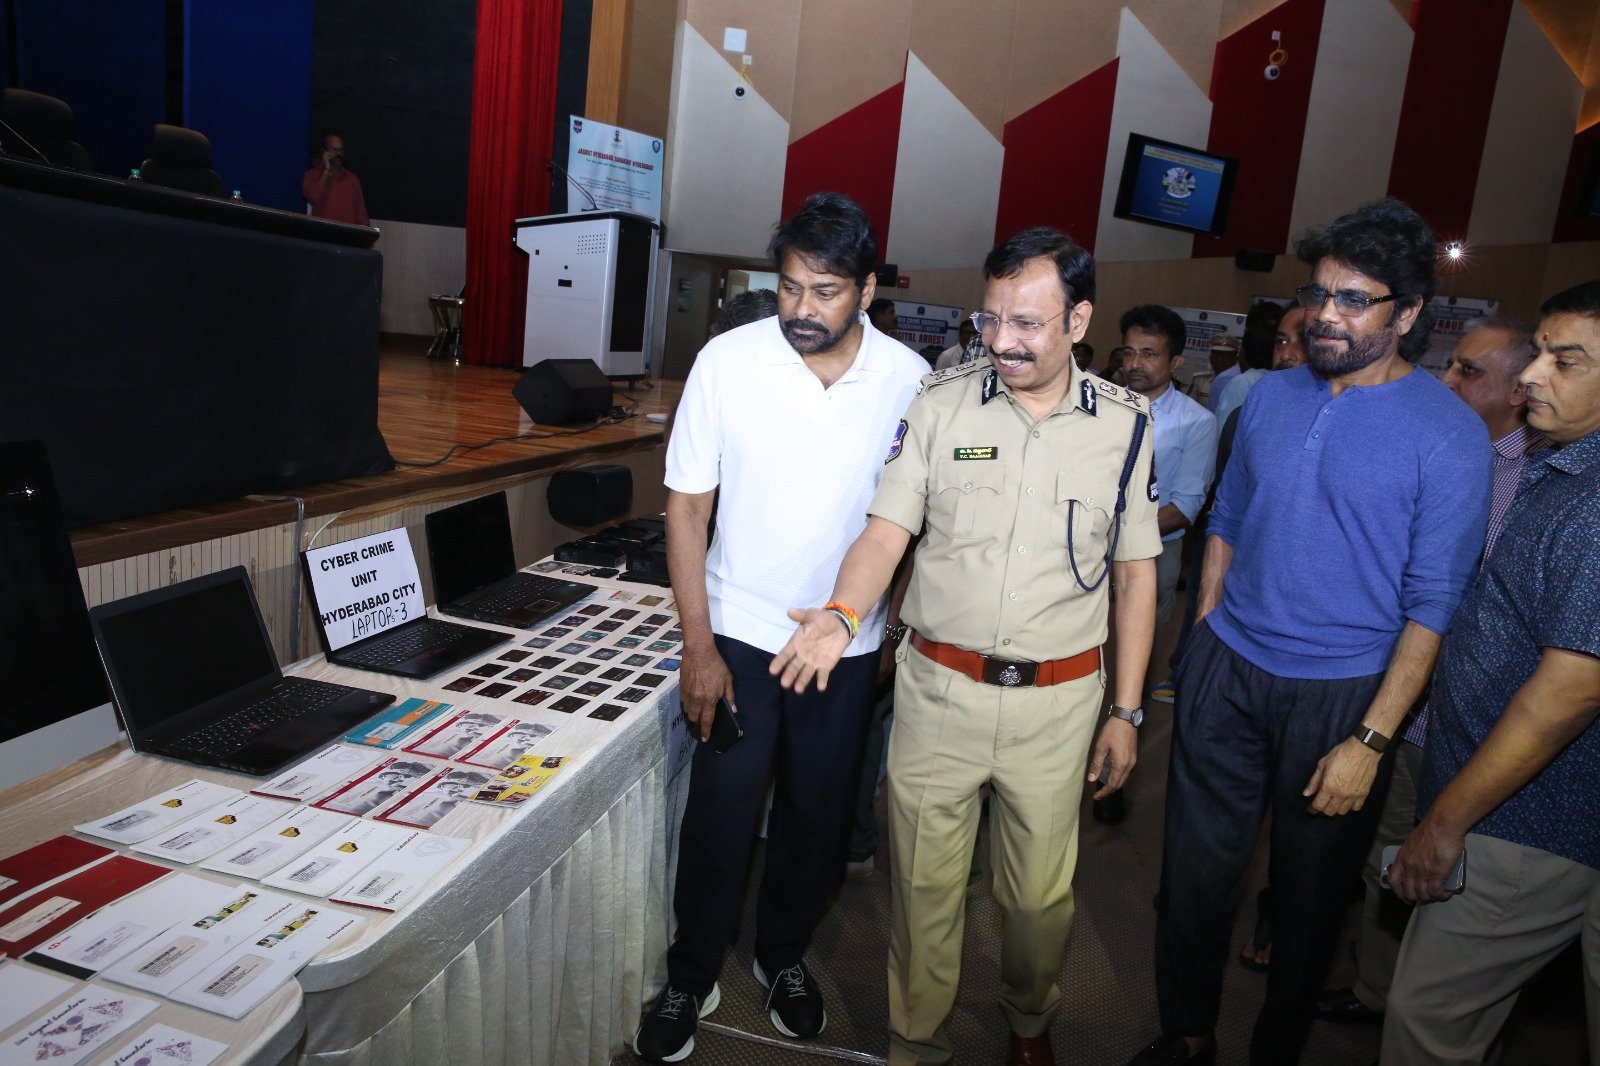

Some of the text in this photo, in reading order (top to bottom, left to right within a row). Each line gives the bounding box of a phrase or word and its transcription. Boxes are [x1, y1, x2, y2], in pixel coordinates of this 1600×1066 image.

[919, 334, 946, 345] ARREST
[321, 541, 395, 571] CYBER CRIME
[351, 570, 377, 587] UNIT
[321, 582, 416, 626] HYDERABAD CITY
